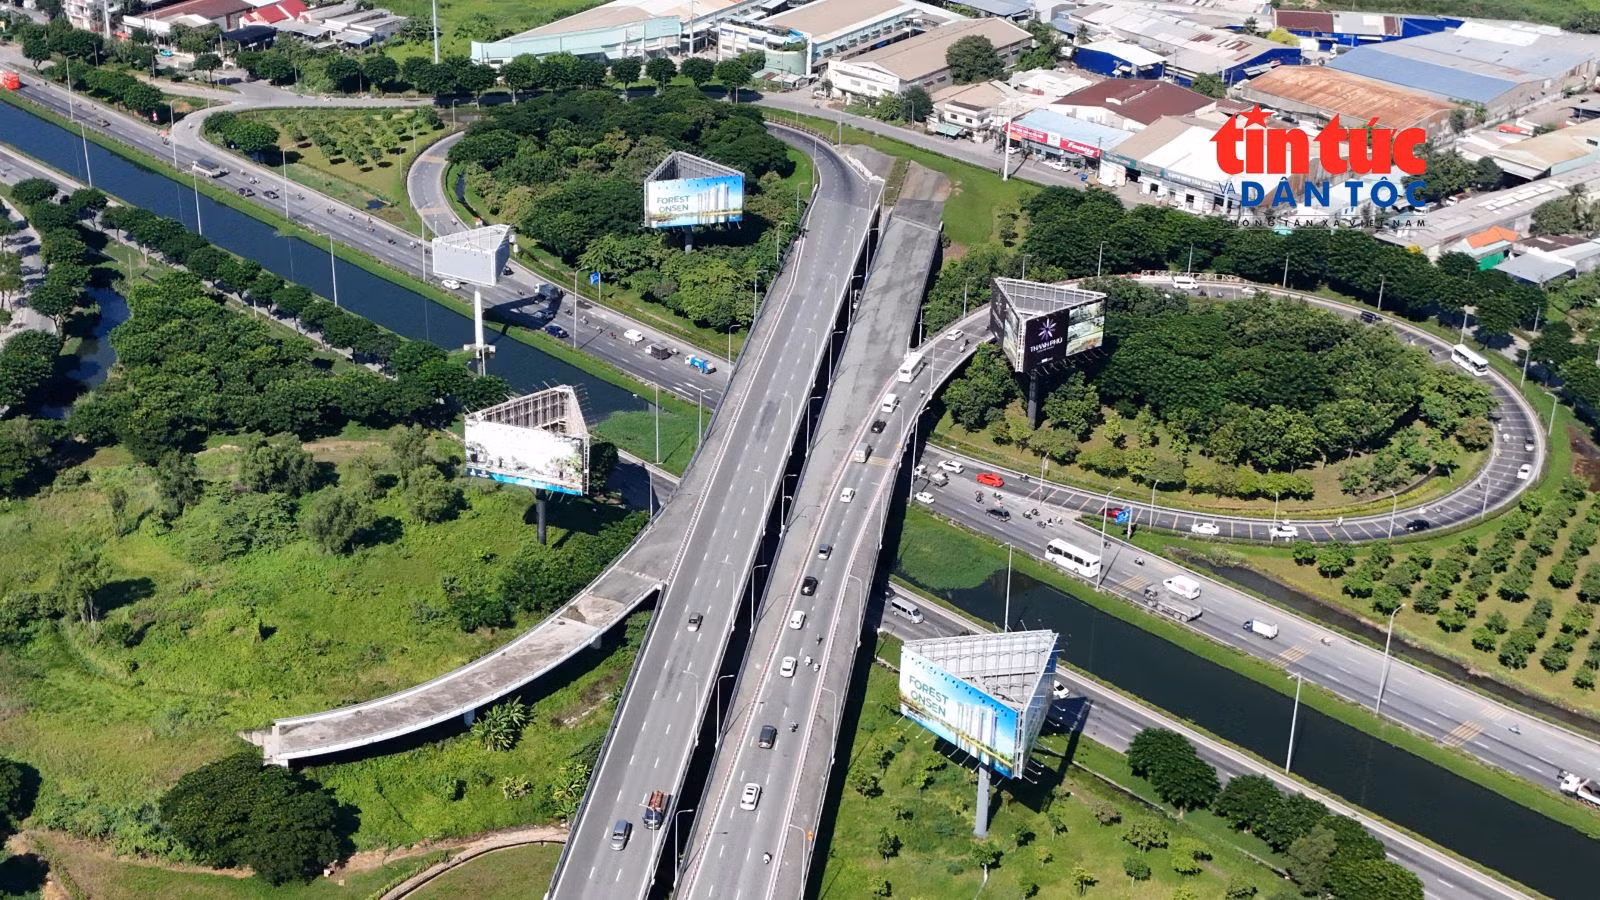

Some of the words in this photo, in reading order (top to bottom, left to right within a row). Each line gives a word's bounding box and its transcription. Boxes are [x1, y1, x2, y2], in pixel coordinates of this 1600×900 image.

[656, 195, 690, 204] FOREST
[658, 204, 689, 213] ONSEN
[909, 675, 949, 705] FOREST
[910, 690, 946, 717] ONSEN
